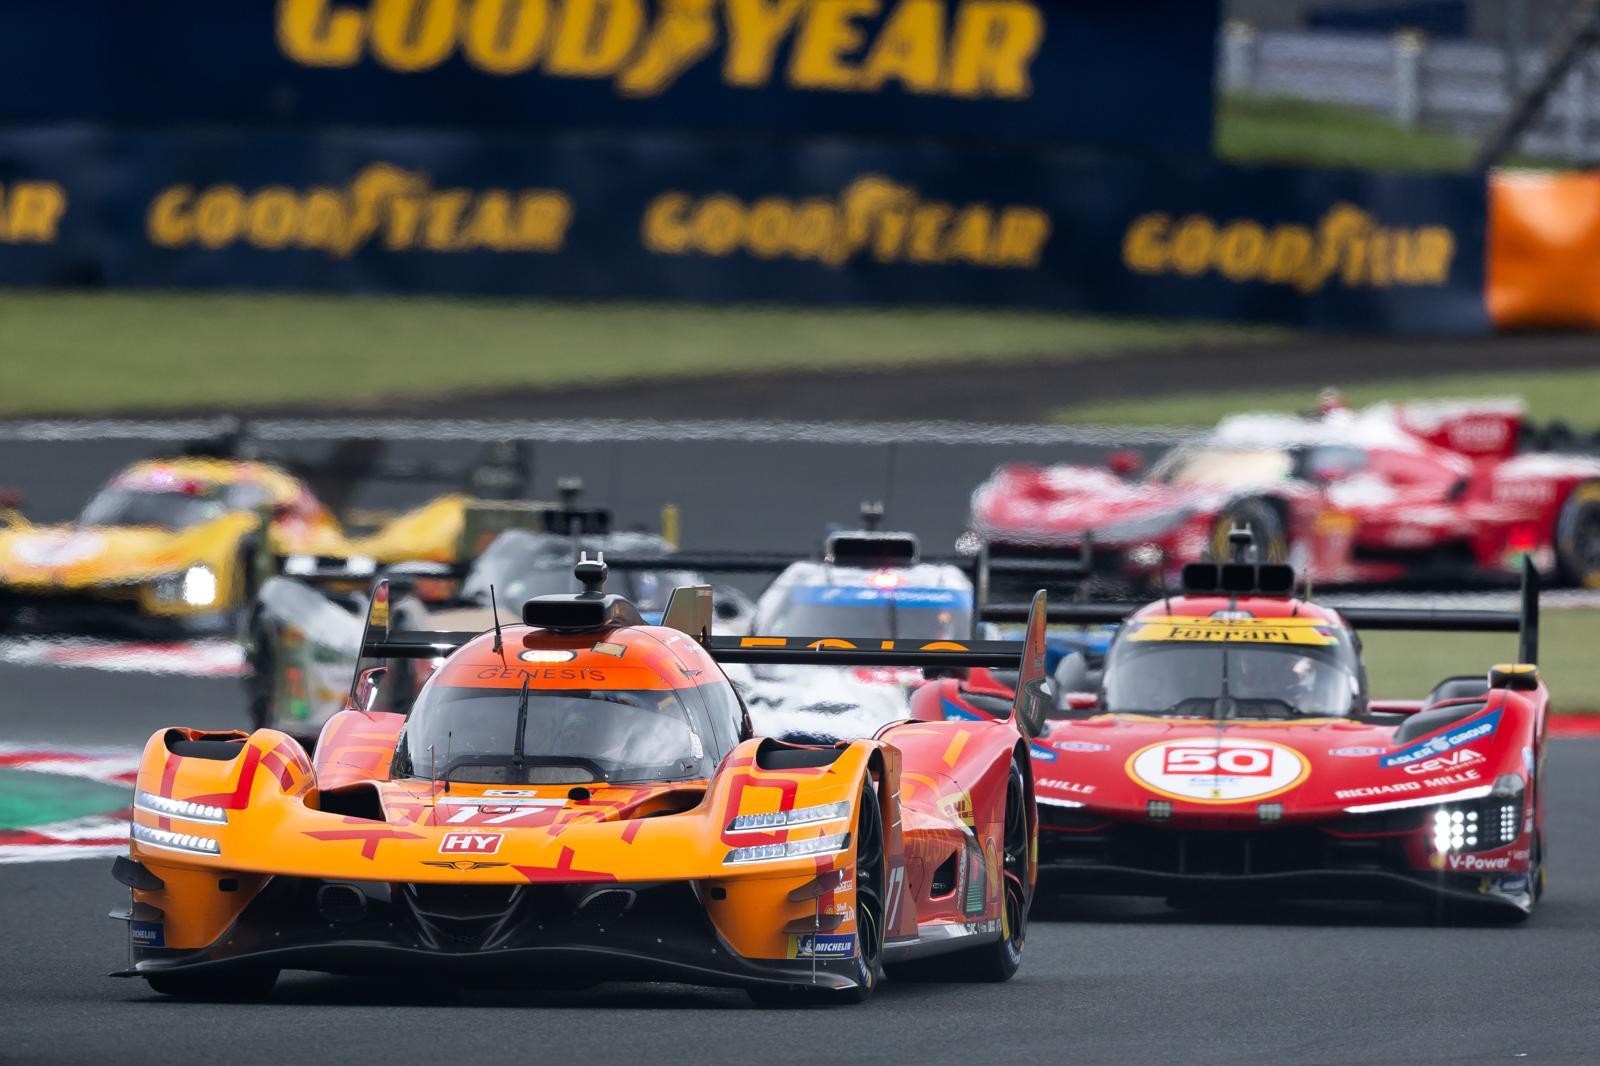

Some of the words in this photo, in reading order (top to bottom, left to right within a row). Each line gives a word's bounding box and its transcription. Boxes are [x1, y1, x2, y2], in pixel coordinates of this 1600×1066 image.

[278, 0, 1043, 97] GOODYEAR
[149, 164, 570, 253] GOODYEAR
[643, 176, 1049, 264] GOODYEAR
[1123, 204, 1453, 291] GOODYEAR
[1168, 626, 1291, 641] Ferrari
[477, 667, 606, 682] GENESIS
[1386, 747, 1435, 767] ADLER
[1448, 723, 1493, 745] GROUP
[1167, 749, 1270, 773] 50
[1036, 777, 1097, 794] MILLE
[1335, 781, 1421, 799] RICHARD
[1423, 769, 1481, 788] MILLE
[446, 806, 548, 824] 17
[446, 836, 498, 849] HY
[1449, 855, 1510, 869] V-Power
[884, 866, 905, 931] 17
[815, 942, 852, 952] MICHELIN
